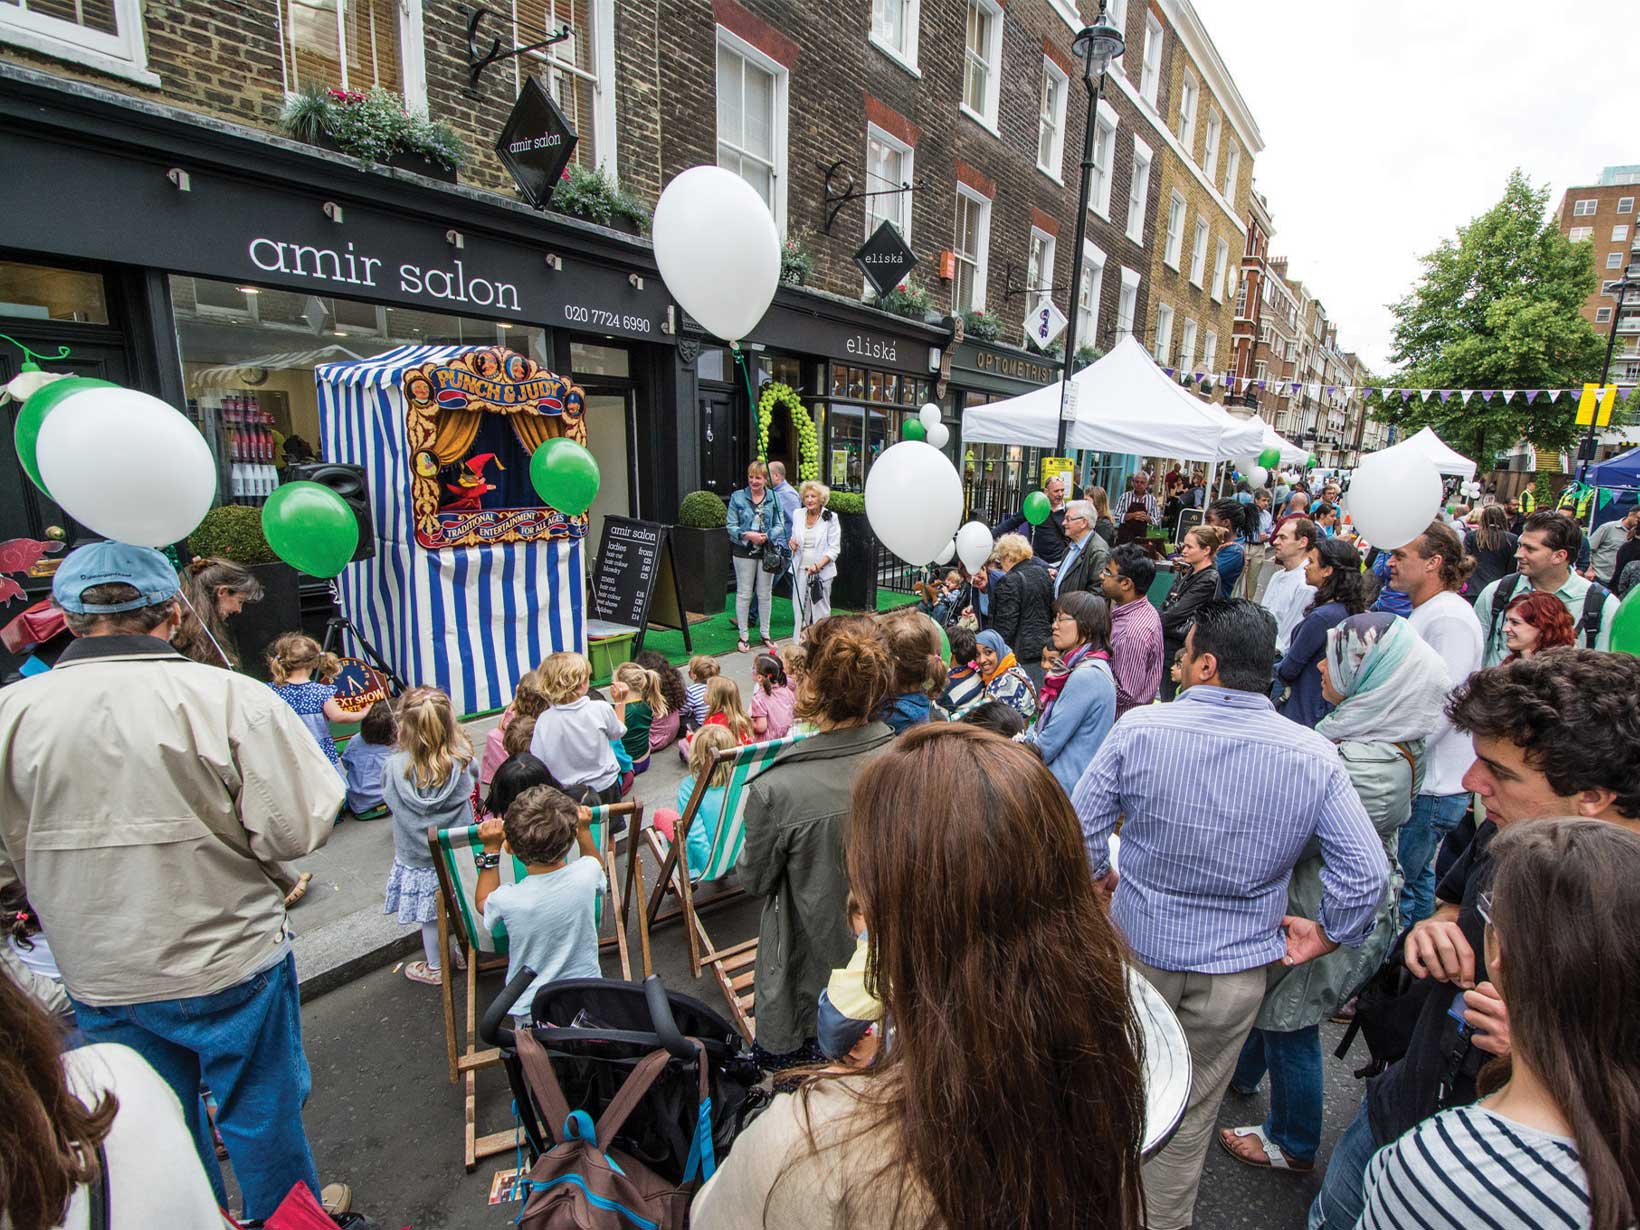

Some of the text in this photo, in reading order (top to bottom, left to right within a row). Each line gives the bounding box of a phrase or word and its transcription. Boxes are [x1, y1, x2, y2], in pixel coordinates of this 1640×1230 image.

[510, 131, 561, 153] amir salon
[865, 251, 903, 264] eliská
[249, 238, 522, 311] amir salon
[564, 304, 650, 333] 020 7724 6990
[846, 335, 897, 361] eliská
[977, 351, 1053, 382] OPTOMETRIST
[436, 369, 561, 403] PUNCH & JUDY
[447, 513, 564, 538] TRADITIONAL ENTERTAINMENT FOR ALL AGES
[611, 526, 656, 541] amir salon
[607, 541, 653, 557] ladies from
[334, 697, 353, 707] EXT
[355, 687, 385, 704] SHOW
